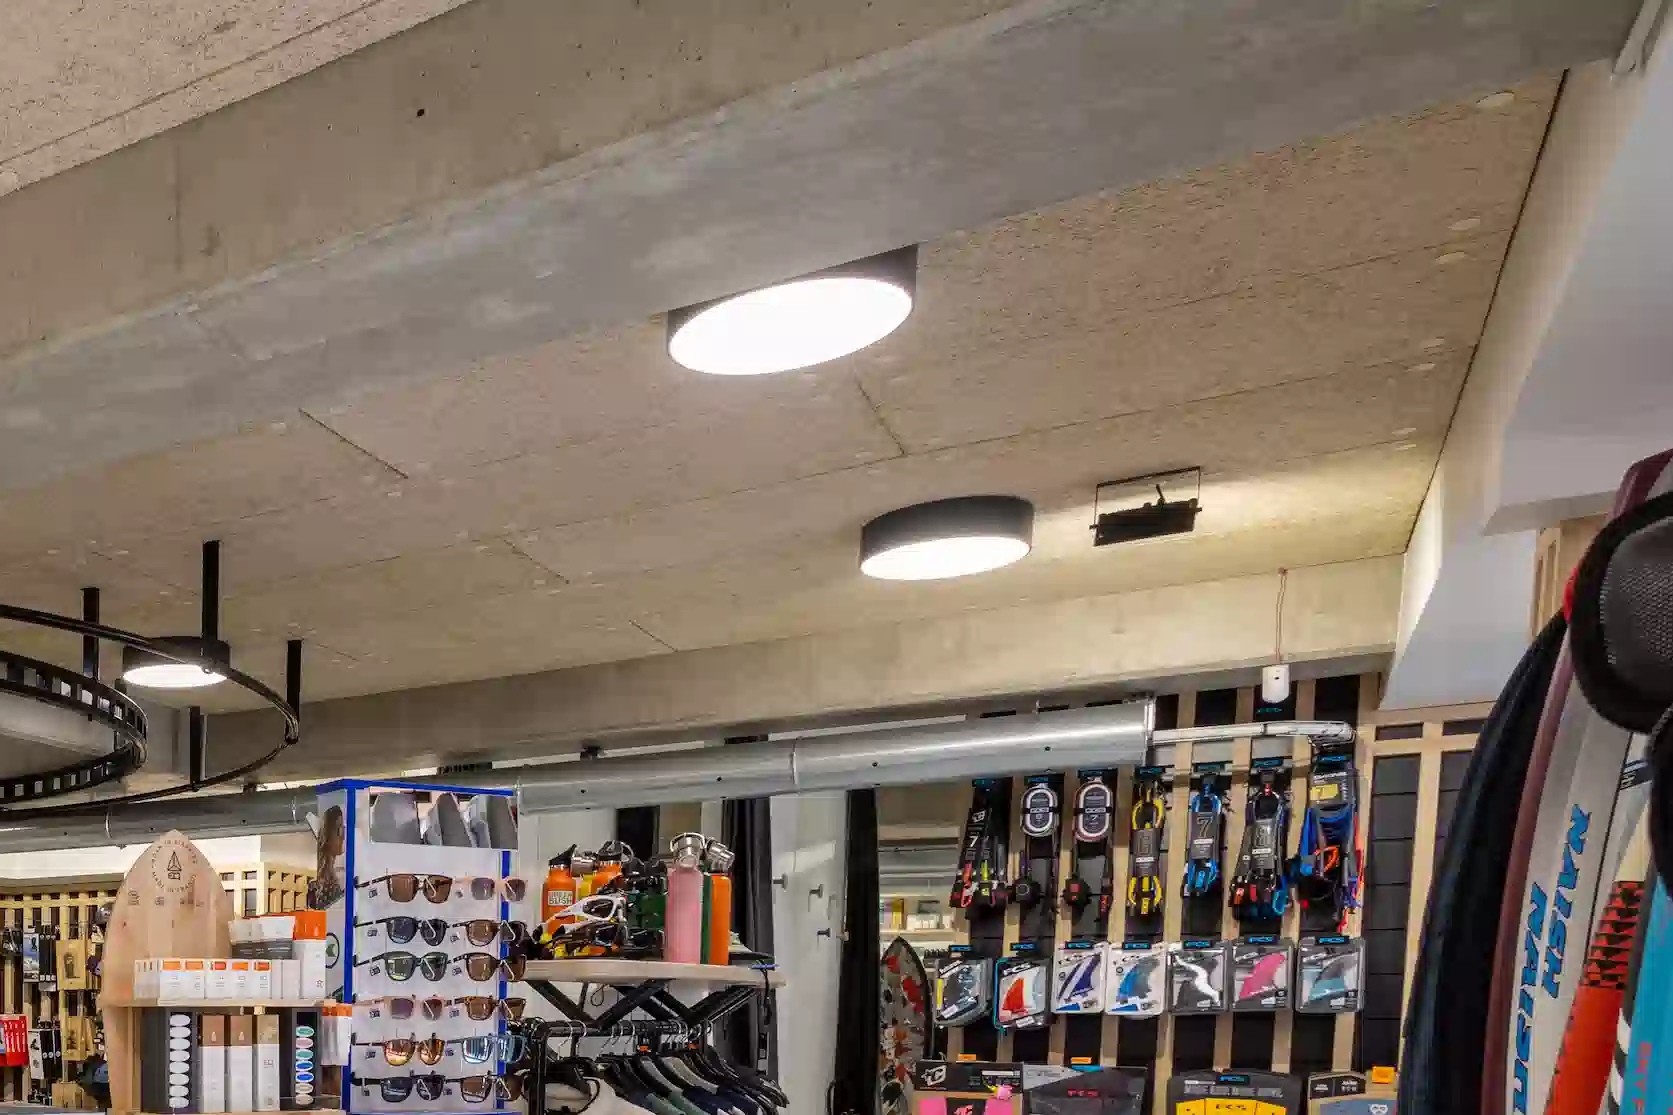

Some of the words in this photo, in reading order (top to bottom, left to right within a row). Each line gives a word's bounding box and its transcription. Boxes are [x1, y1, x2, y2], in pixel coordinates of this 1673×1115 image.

[1196, 816, 1213, 839] 7
[968, 835, 978, 847] 7
[1542, 803, 1592, 998] NAISH
[1003, 962, 1031, 976] FCS
